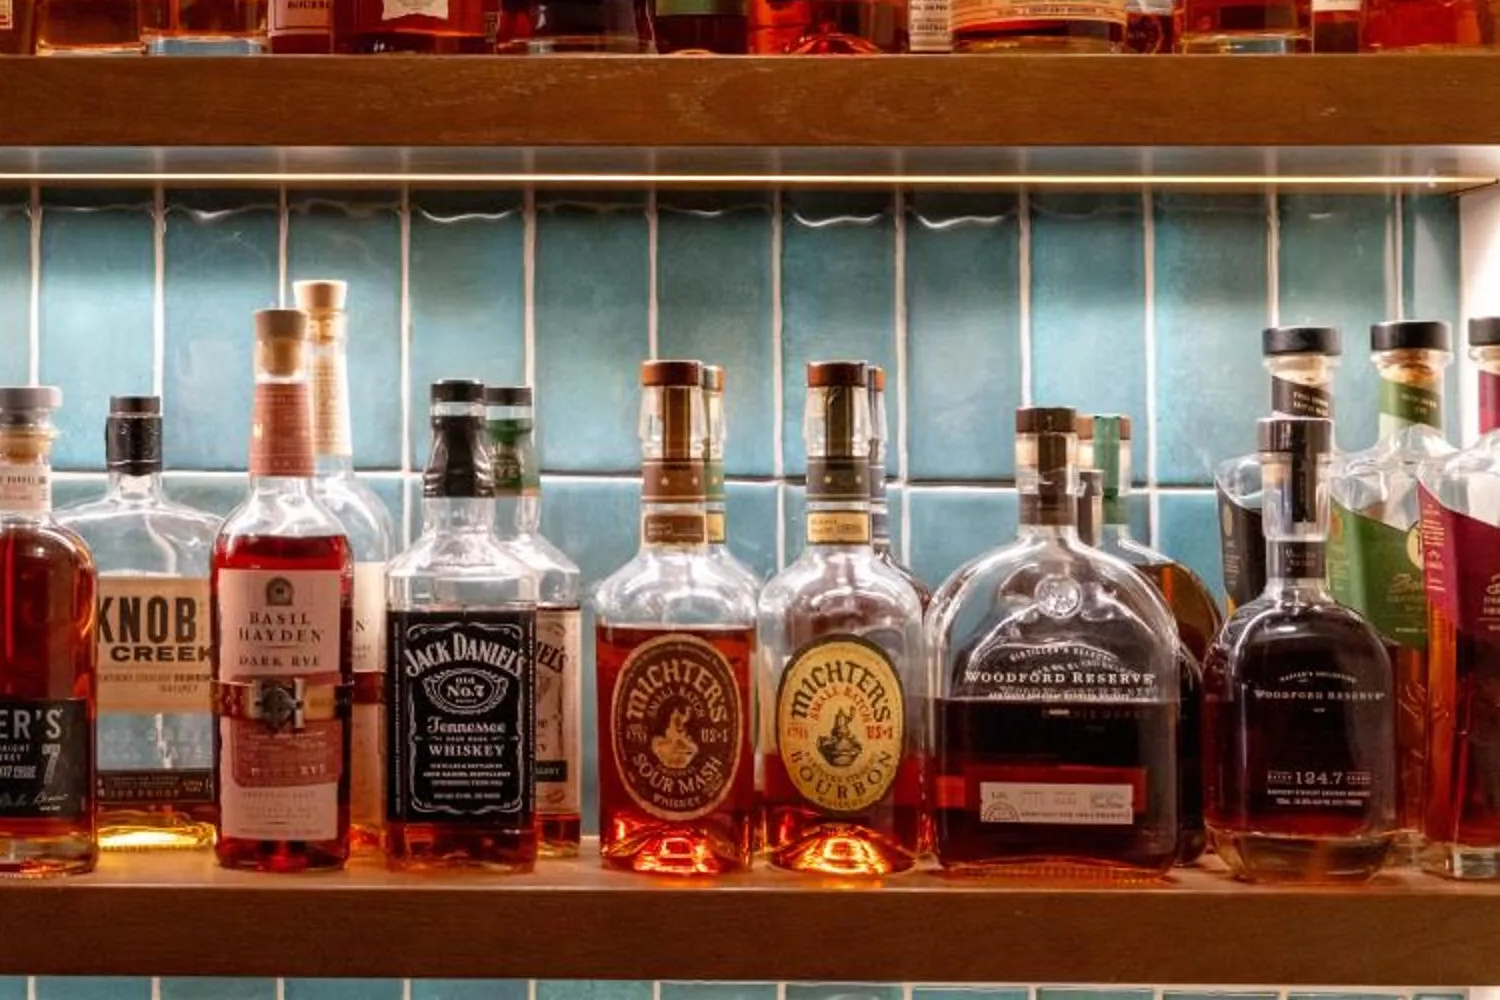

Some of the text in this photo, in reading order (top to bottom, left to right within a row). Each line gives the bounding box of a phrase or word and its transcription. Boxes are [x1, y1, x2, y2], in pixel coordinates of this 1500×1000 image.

[97, 595, 197, 644] KNOB
[249, 611, 312, 626] BASIL
[238, 627, 324, 644] HAYDEN
[238, 654, 321, 667] DARK RYE
[403, 632, 526, 679] JACK DANIEL'S
[625, 659, 729, 724] MICHTER'S
[789, 659, 892, 724] MICHTER'S
[963, 670, 1157, 684] WOODFORD RESERVE
[427, 715, 507, 734] Tennessee
[428, 744, 505, 757] WHISKEY
[631, 753, 725, 797] SOUR MASH
[790, 749, 893, 800] BOURBON
